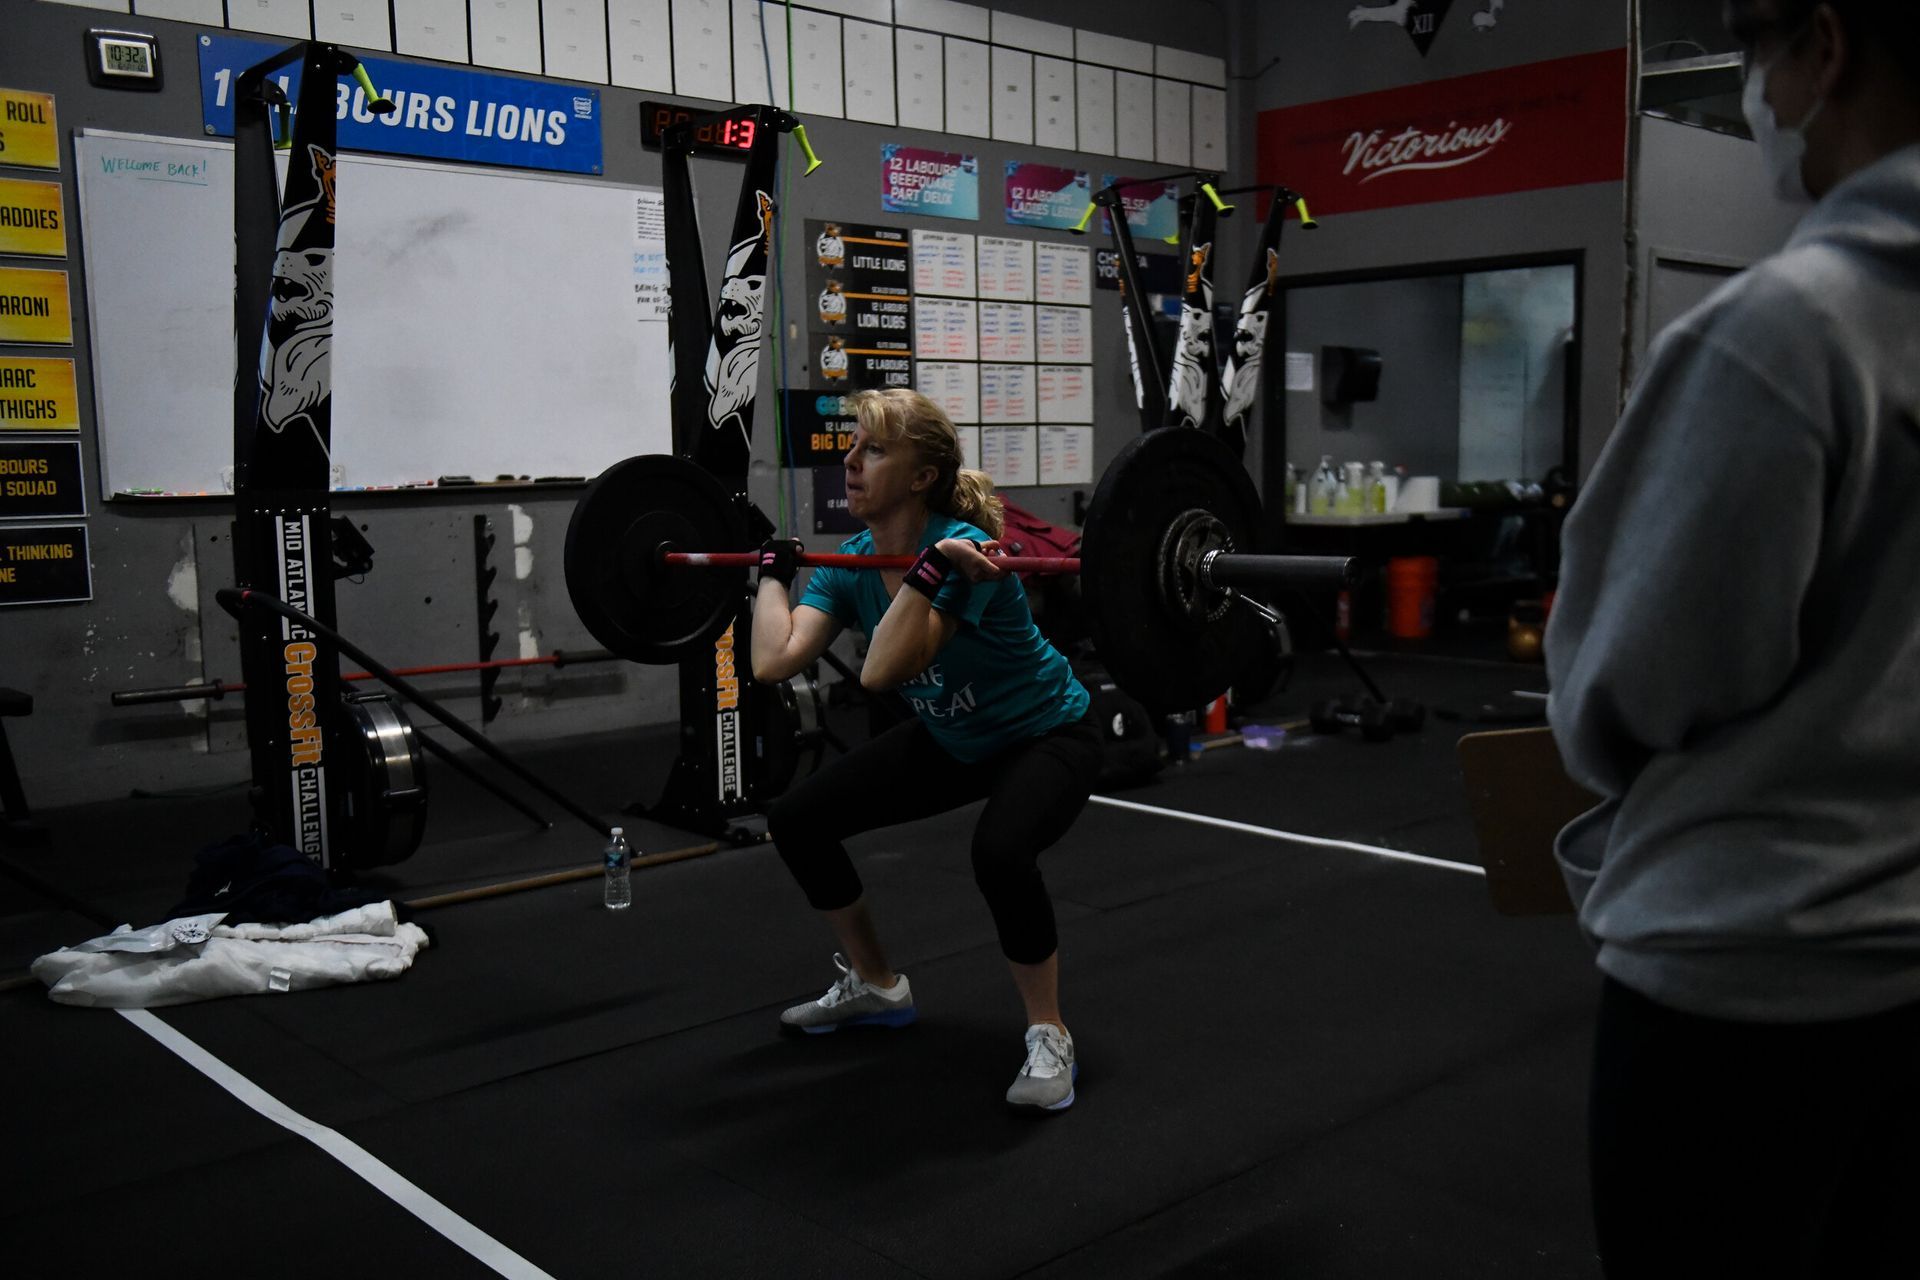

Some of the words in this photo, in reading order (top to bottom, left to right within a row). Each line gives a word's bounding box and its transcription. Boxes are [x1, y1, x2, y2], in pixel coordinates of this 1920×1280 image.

[1411, 13, 1435, 34] XII
[111, 46, 139, 63] 10:32
[7, 100, 46, 124] ROLL
[274, 76, 456, 133] LBOURS
[465, 99, 567, 146] LIONS
[1341, 116, 1513, 176] Victorious
[101, 155, 160, 174] WELCOME
[889, 157, 903, 171] 12
[905, 160, 957, 177] LABOURS
[890, 187, 921, 202] PART
[1012, 187, 1025, 200] 12
[853, 255, 881, 269] LITTLE
[882, 257, 906, 272] LIONS
[0, 295, 49, 317] ARONI
[857, 313, 880, 328] LION
[881, 314, 906, 329] CUBS
[866, 359, 875, 370] 12
[0, 368, 36, 388] AAC
[885, 371, 909, 385] LIONS
[0, 399, 57, 419] THIGHS
[825, 421, 834, 432] 12
[811, 433, 833, 450] BIG
[6, 480, 58, 496] SQUAD
[285, 521, 303, 551] MID
[6, 544, 74, 561] THINKING
[287, 558, 307, 640] ATLANIC
[899, 682, 977, 718] PEAT
[722, 711, 737, 793] CHALLENGE
